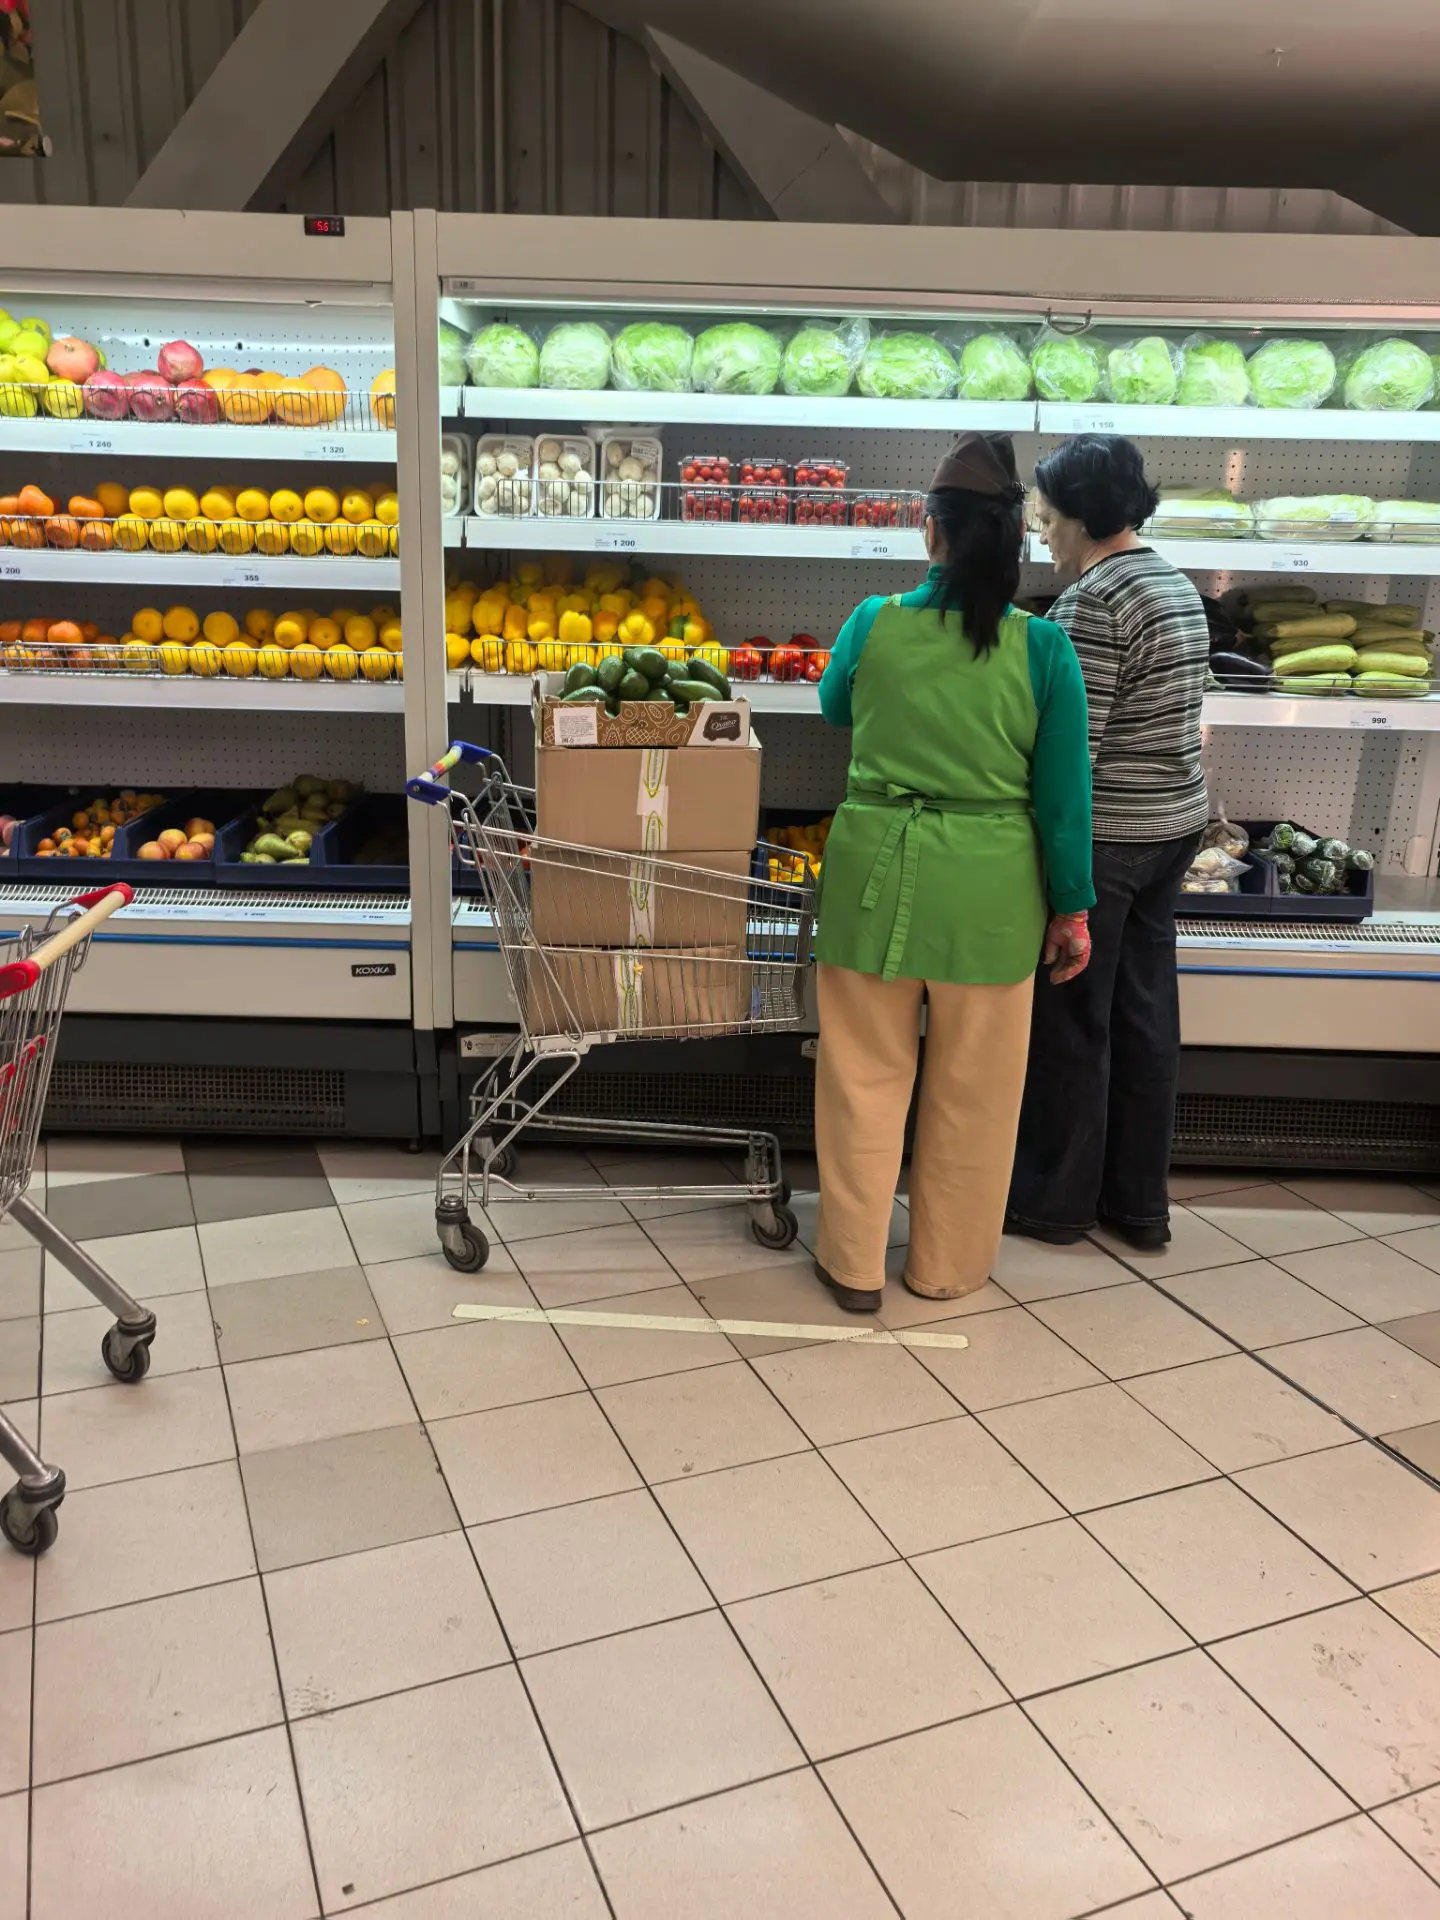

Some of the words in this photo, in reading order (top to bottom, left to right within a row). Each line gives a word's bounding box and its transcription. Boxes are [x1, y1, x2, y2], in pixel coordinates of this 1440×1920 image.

[96, 440, 112, 448] 240
[329, 446, 345, 454] 320
[620, 539, 636, 547] 200
[872, 546, 888, 554] 410
[1293, 559, 1309, 567] 930
[5, 567, 21, 575] 200
[1371, 717, 1387, 725] 990
[355, 966, 390, 975] KOXKA
